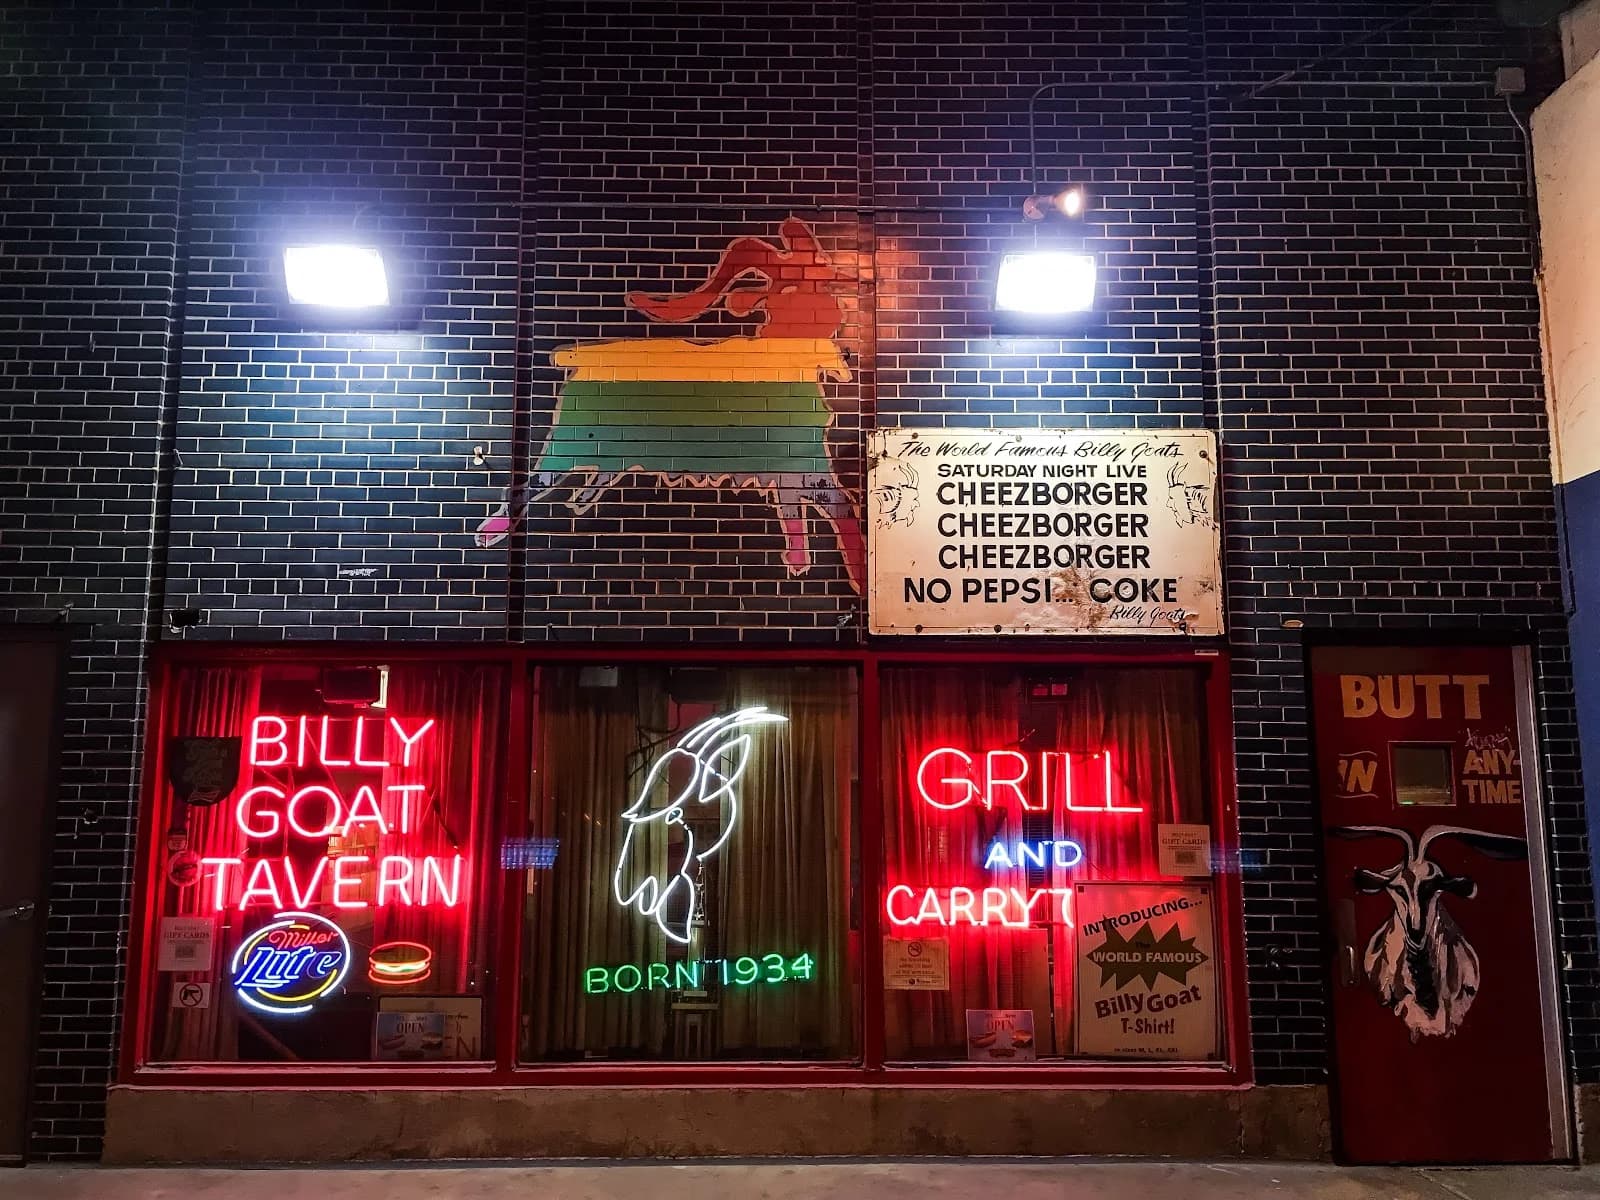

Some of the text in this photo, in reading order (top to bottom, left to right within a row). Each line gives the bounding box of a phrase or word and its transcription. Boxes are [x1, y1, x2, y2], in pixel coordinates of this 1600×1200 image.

[898, 441, 1184, 462] The World Famous Billy Goats
[937, 464, 1147, 478] SATURDAY NIGHT LIVE
[937, 482, 1148, 506] CHEEZBORGER
[937, 513, 1149, 538] CHEEZBORGER
[938, 544, 1150, 569] CHEEZBORGER
[904, 577, 951, 603] NO
[1090, 577, 1177, 603] COKE
[1110, 605, 1185, 624] Billy Goats
[1340, 674, 1489, 720] BUTT
[250, 715, 435, 767] BILLY
[1463, 749, 1521, 775] ANY-
[916, 747, 1143, 812] GRILL
[1462, 779, 1521, 804] TIME
[236, 785, 426, 838] GOAT
[984, 840, 1083, 869] AND
[201, 855, 461, 912] TAVERN
[886, 885, 1045, 928] CARRY
[1083, 897, 1203, 937] INTRODUCING...
[268, 929, 339, 951] Miller
[1093, 952, 1202, 963] WORLD FAMOUS
[586, 953, 814, 994] BORN 1934
[1095, 985, 1202, 1018] Billy Goat
[1121, 1017, 1175, 1034] T-Shirt!
